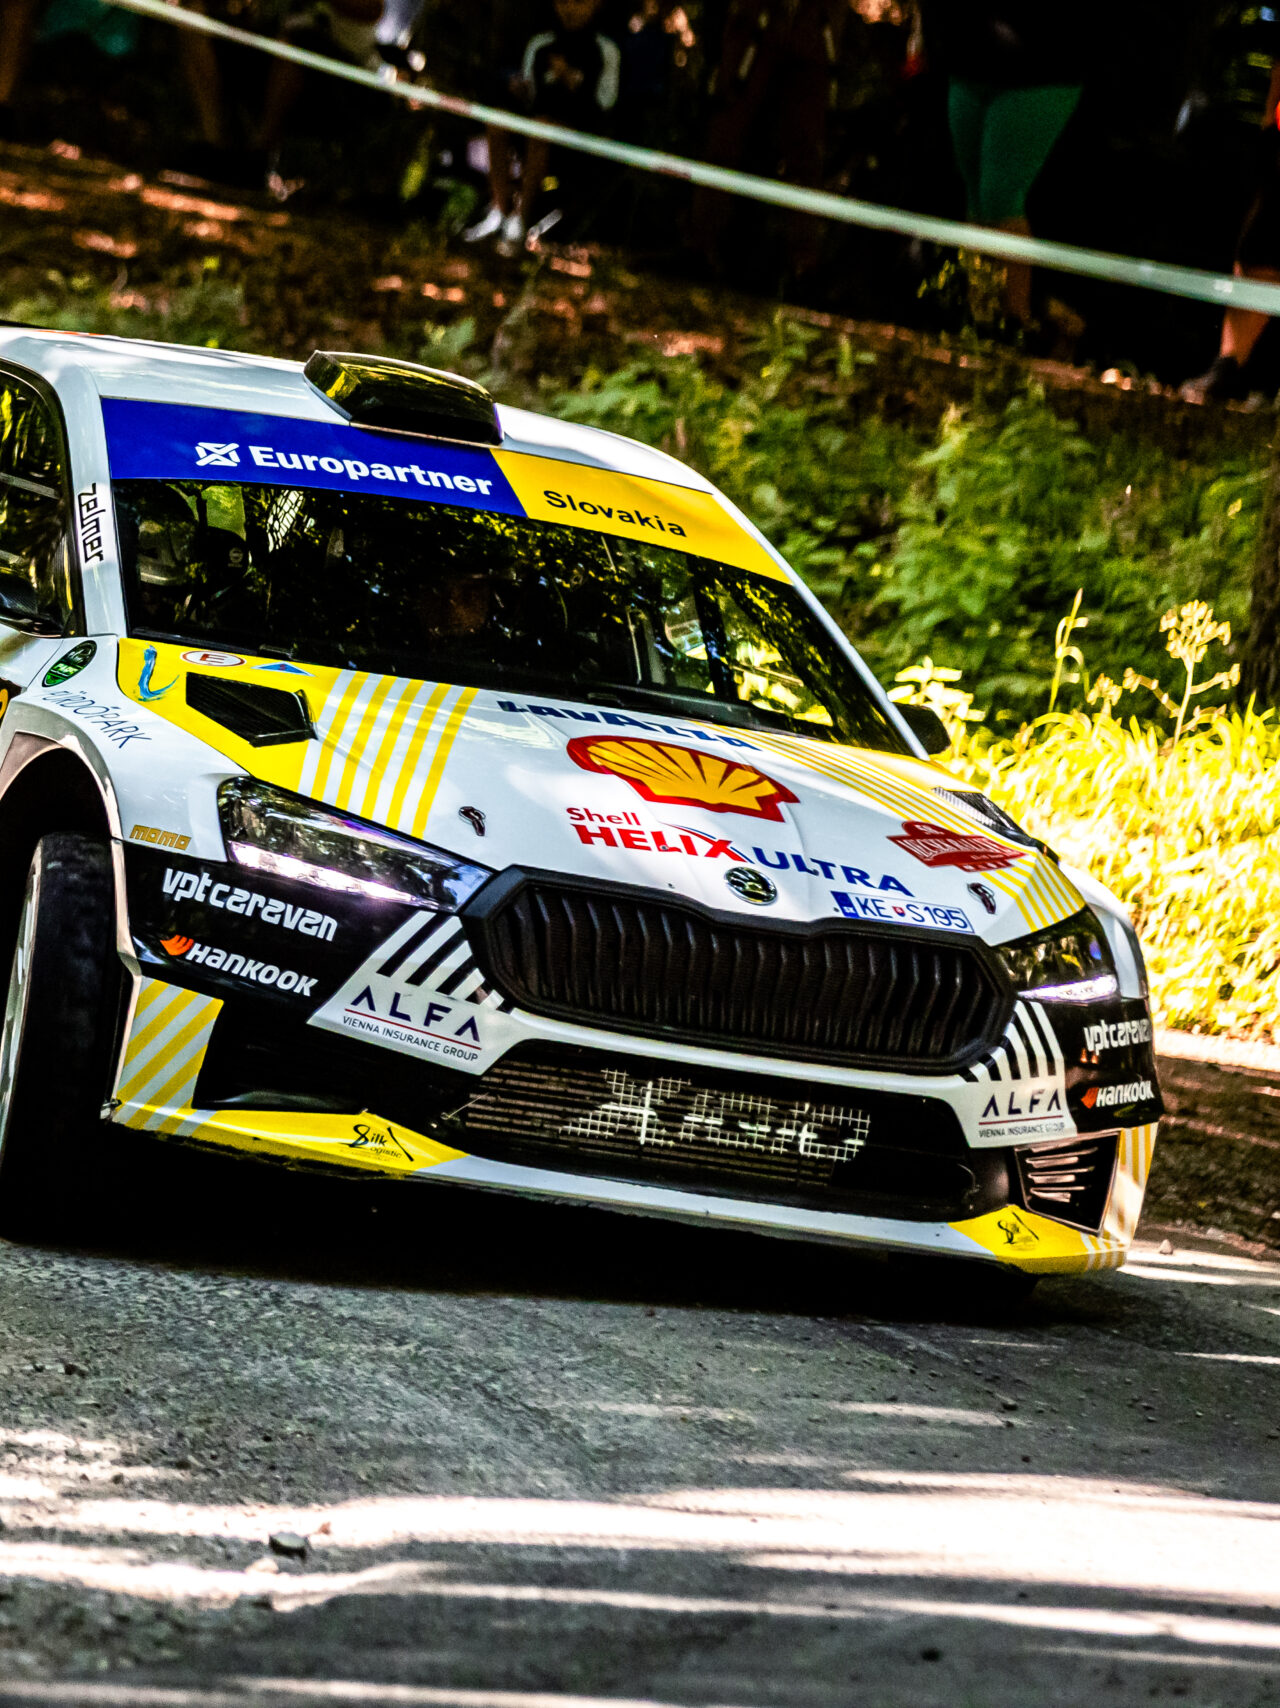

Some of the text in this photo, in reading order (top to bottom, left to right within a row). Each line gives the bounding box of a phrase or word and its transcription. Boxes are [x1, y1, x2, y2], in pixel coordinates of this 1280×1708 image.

[248, 445, 493, 495] Europartner
[543, 489, 687, 538] Slovakia
[566, 807, 642, 826] Shell
[570, 823, 750, 864] HELIX
[752, 846, 916, 898] ULTRA
[854, 895, 894, 919] KE
[350, 985, 481, 1043] ALFA
[343, 1015, 479, 1062] VIENNA INSURANCE GROUP
[981, 1088, 1062, 1118] ALFA
[978, 1128, 1006, 1138] VIENNA
[1007, 1123, 1045, 1136] INSURANCE
